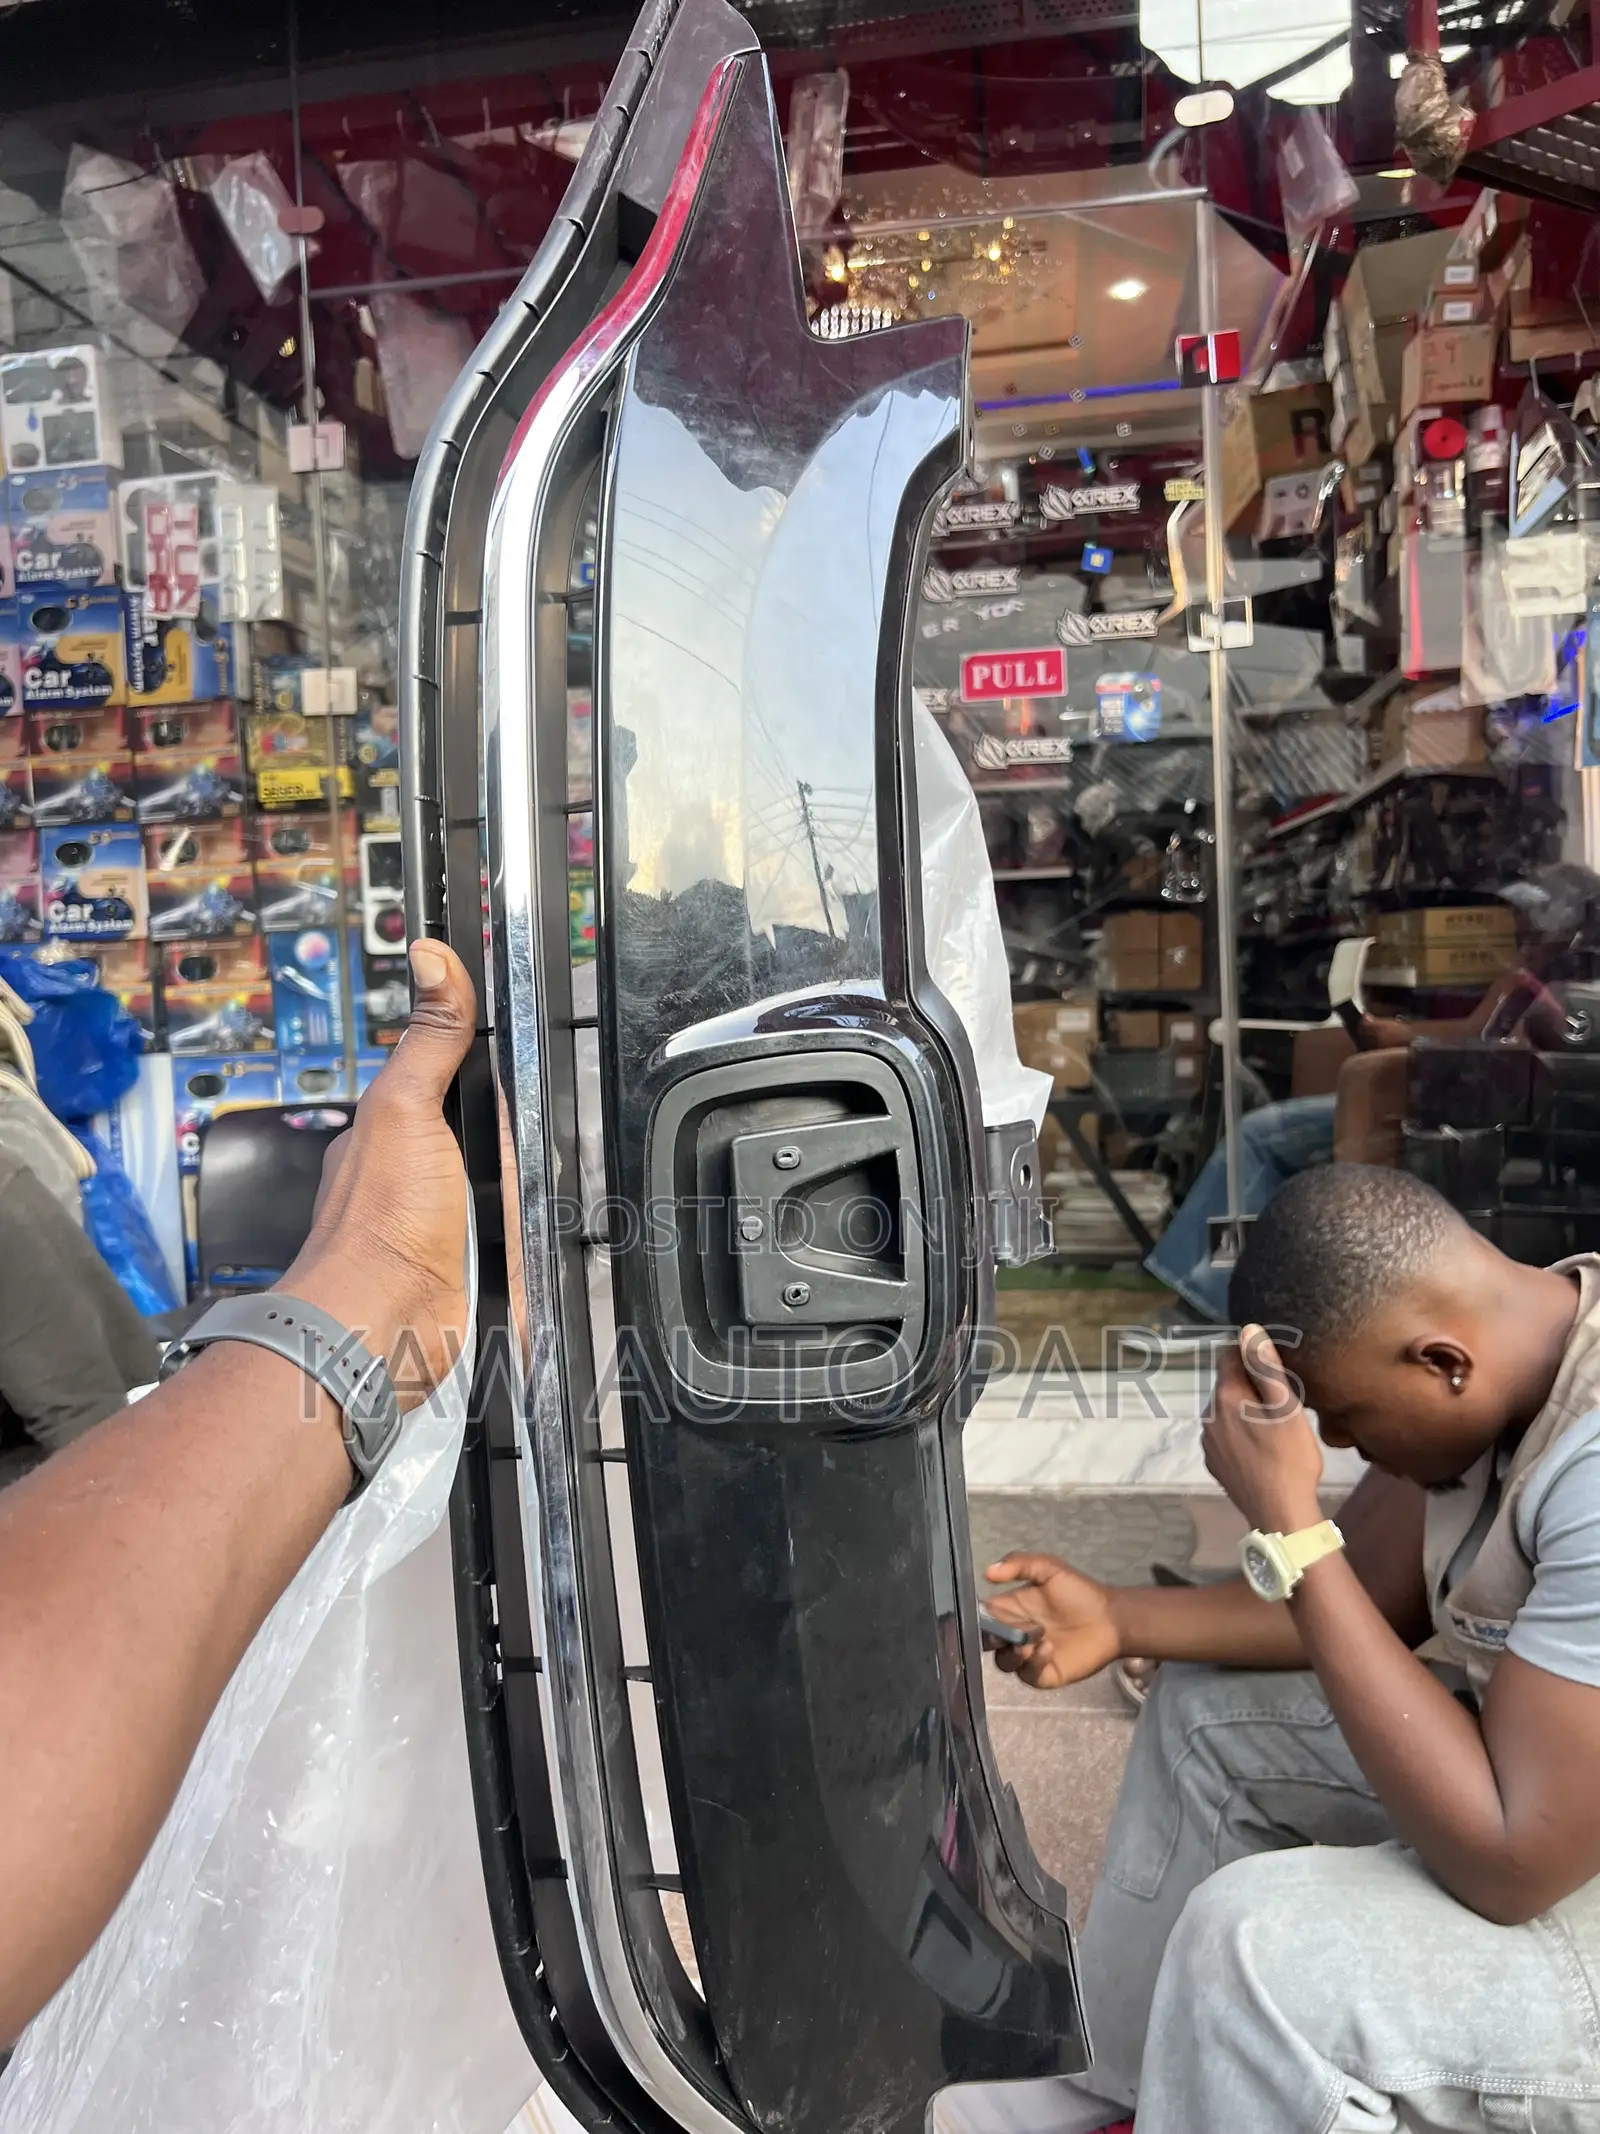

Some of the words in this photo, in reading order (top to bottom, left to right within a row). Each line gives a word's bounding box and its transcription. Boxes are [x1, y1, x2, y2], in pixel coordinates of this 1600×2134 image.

[17, 549, 61, 571] Car
[142, 619, 160, 648] ar
[25, 667, 72, 690] Car
[971, 659, 1058, 690] PULL
[48, 899, 94, 923] Car
